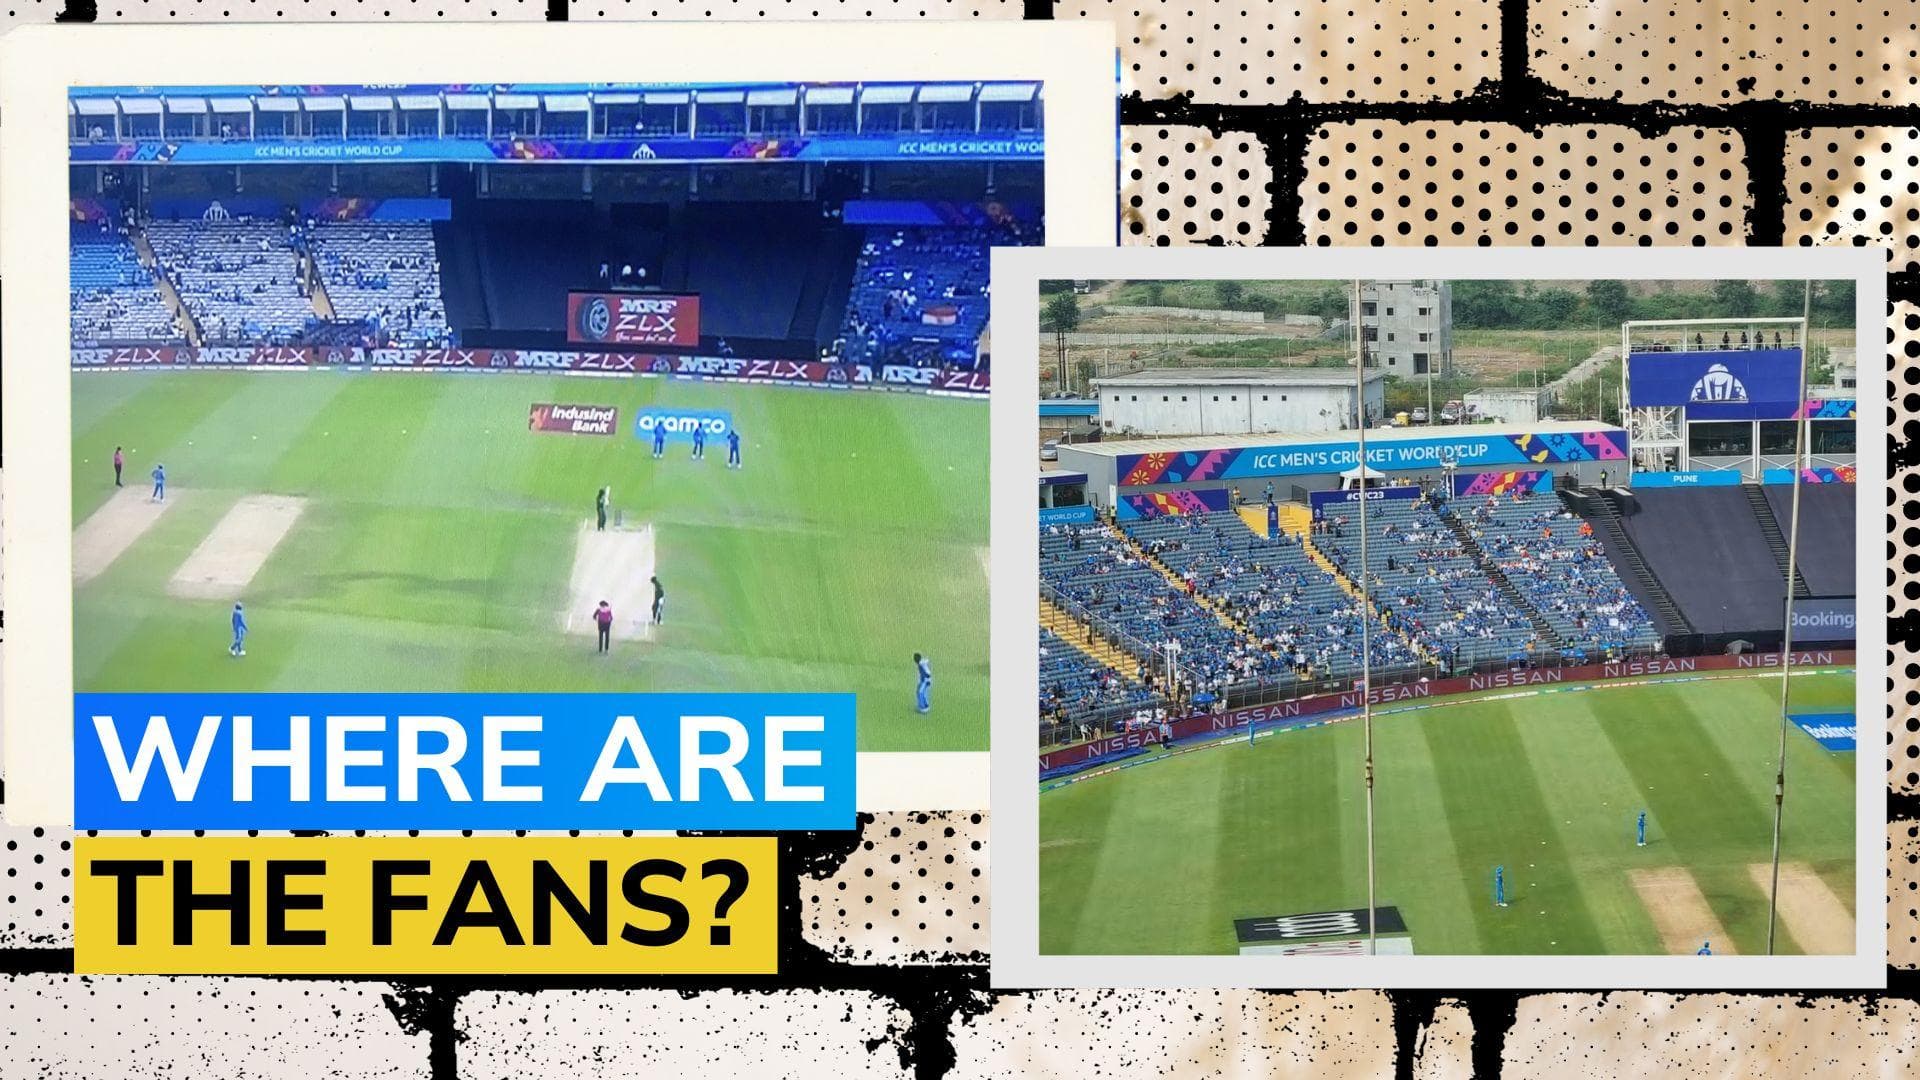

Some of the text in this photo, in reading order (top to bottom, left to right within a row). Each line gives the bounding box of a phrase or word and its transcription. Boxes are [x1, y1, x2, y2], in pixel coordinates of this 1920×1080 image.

[271, 146, 300, 157] MEN'S
[302, 145, 342, 157] CRICKET
[345, 145, 381, 156] WORLD
[381, 144, 403, 155] CUP
[898, 142, 917, 154] ICC
[920, 142, 957, 154] MEN'S
[959, 142, 1012, 154] CRICKET
[619, 298, 677, 314] MRF
[615, 314, 676, 332] ZLX
[114, 348, 162, 363] ZLX
[196, 348, 256, 363] MRF
[422, 349, 475, 366] ZLX
[514, 350, 640, 370] MRF ZLX
[677, 356, 809, 378] MRF ZLX
[944, 371, 990, 390] ZL
[552, 405, 615, 422] IndusInd
[572, 420, 609, 433] Bank
[1254, 453, 1279, 469] ICC
[1281, 450, 1328, 467] MEN'S
[1330, 448, 1395, 465] CRICKET
[1457, 443, 1489, 458] CUP
[1672, 474, 1699, 483] PUNE
[1047, 512, 1072, 521] WORLD
[1072, 511, 1086, 519] CUP
[1604, 658, 1696, 678] NISSAN
[1470, 669, 1563, 691] NISSAN
[1341, 683, 1429, 708] NISSAN
[1212, 702, 1300, 731] NISSAN
